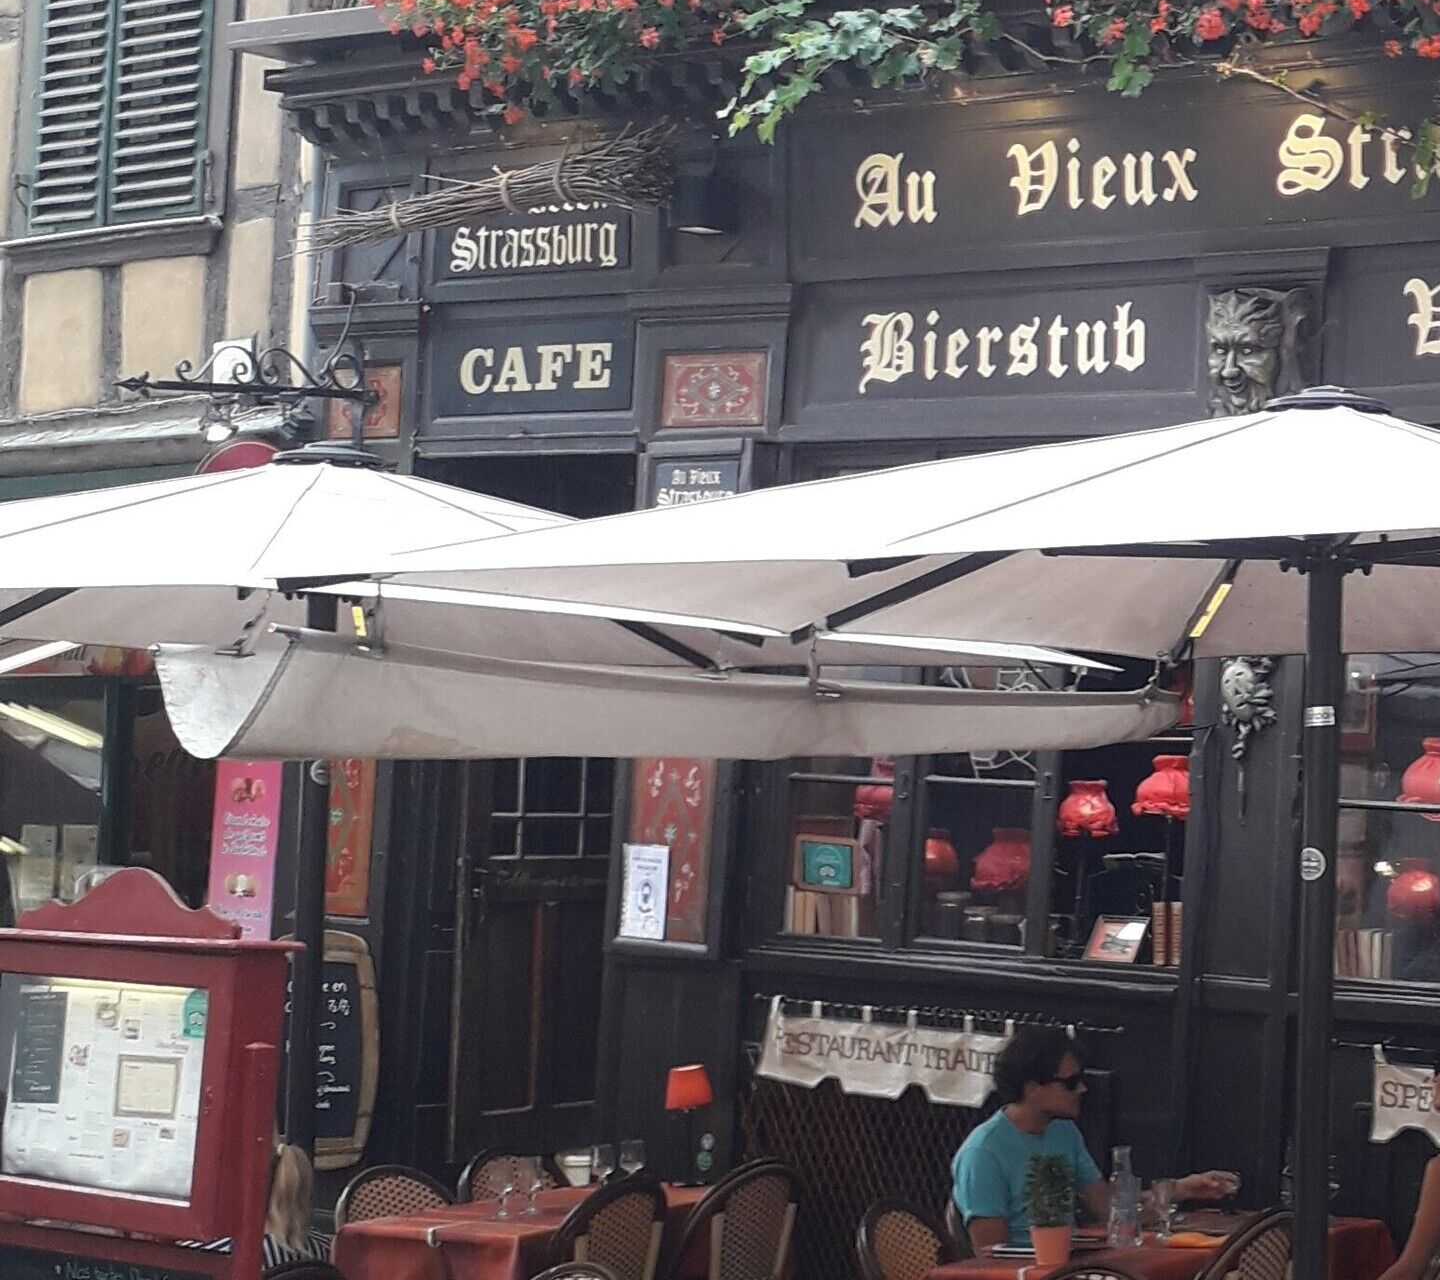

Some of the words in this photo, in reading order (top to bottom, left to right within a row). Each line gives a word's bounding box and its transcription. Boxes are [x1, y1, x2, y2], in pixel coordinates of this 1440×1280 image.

[854, 151, 938, 228] Au
[1007, 131, 1199, 216] Vieux
[449, 222, 618, 273] Strassburg
[460, 342, 613, 395] CAFE
[858, 301, 1146, 394] Bierstub
